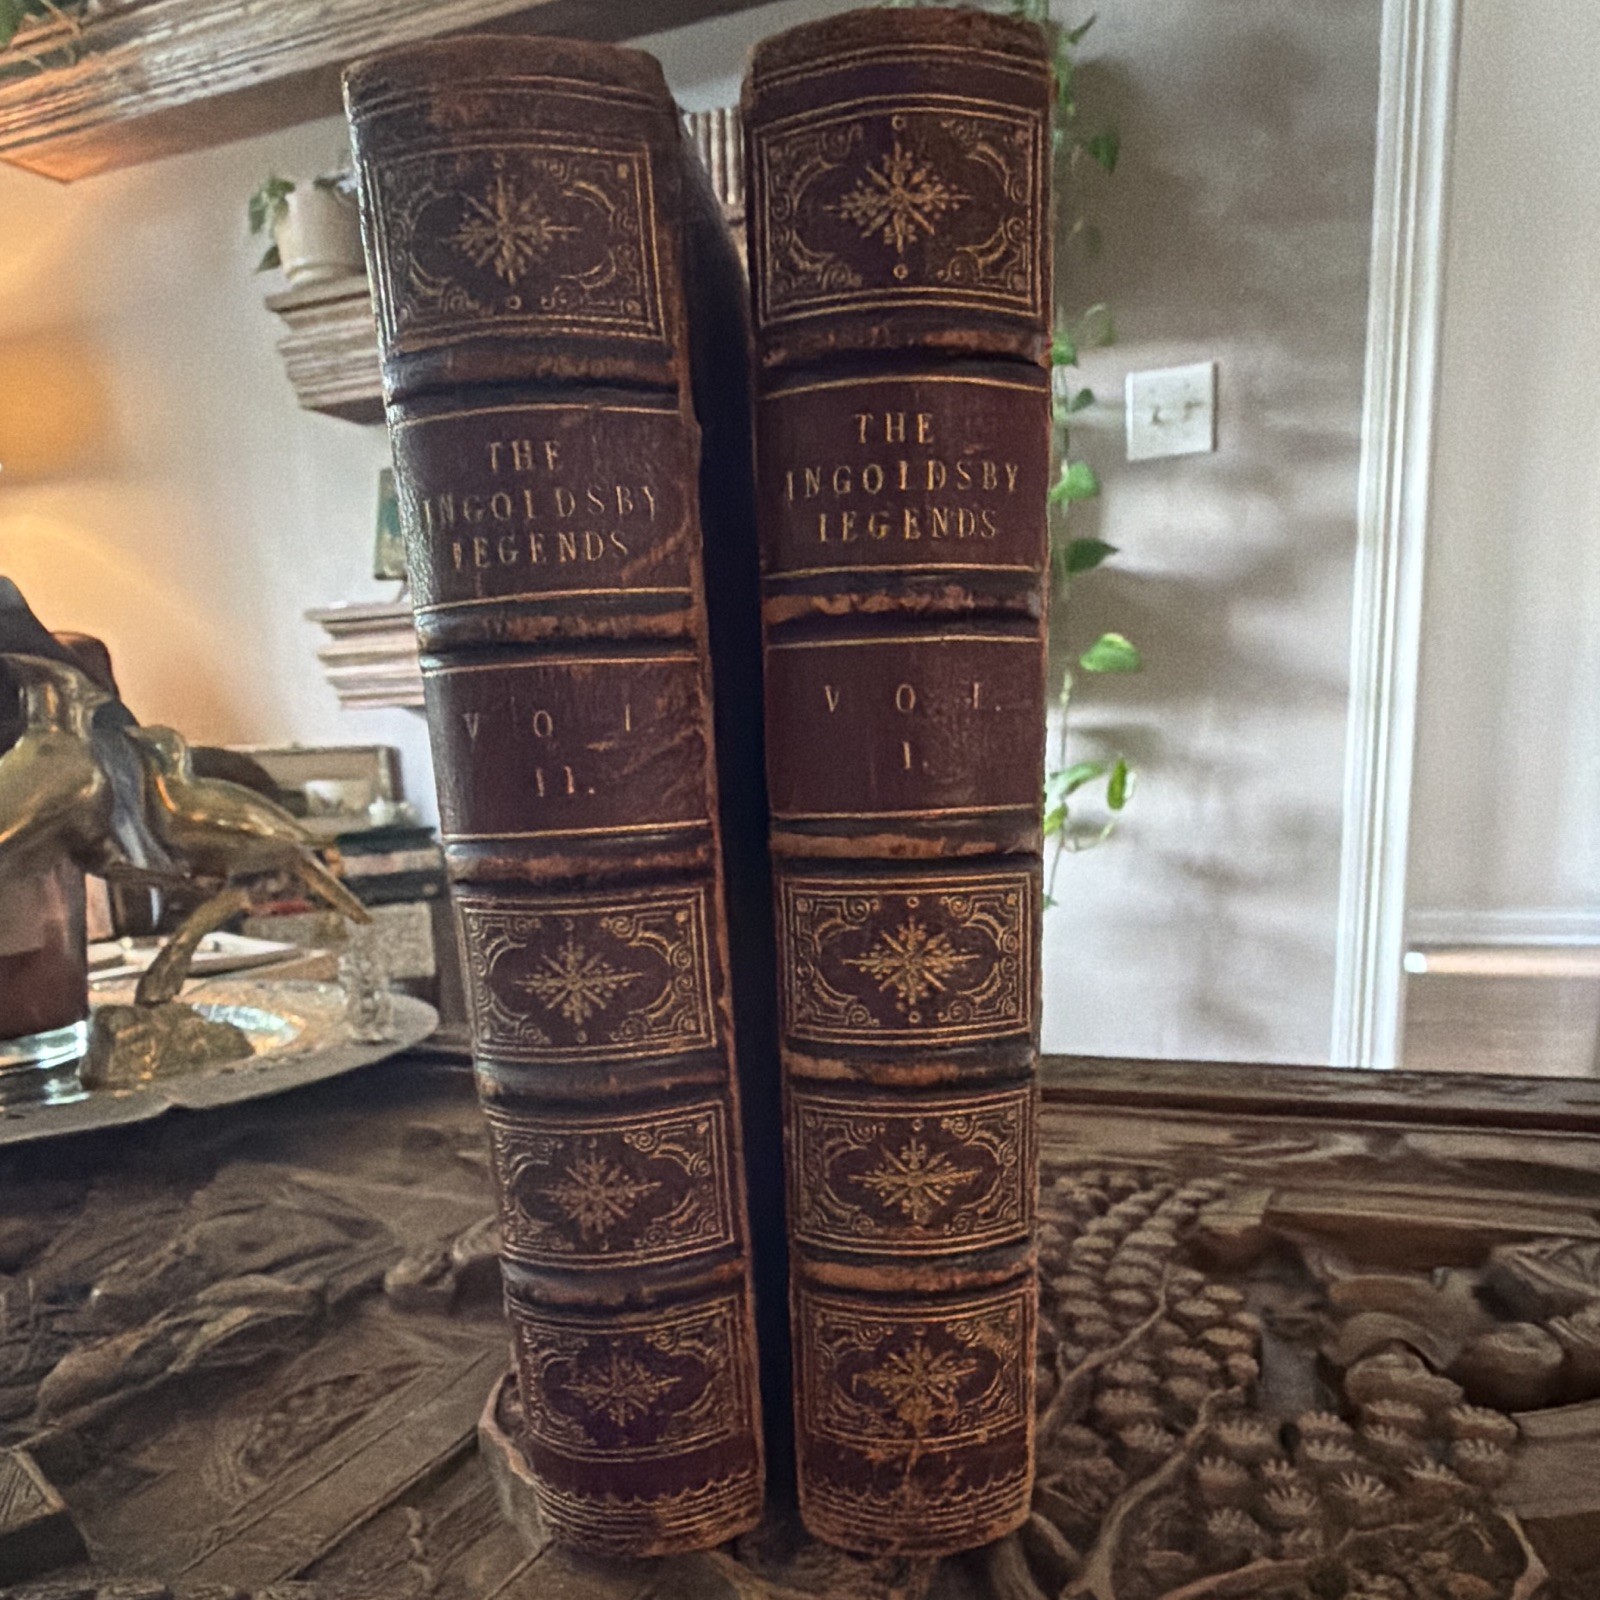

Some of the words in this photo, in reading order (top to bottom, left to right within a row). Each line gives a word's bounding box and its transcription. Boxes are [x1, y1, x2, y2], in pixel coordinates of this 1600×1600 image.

[855, 413, 934, 444] THE
[489, 439, 561, 473] THE
[784, 460, 1019, 502] INGOLDSBY
